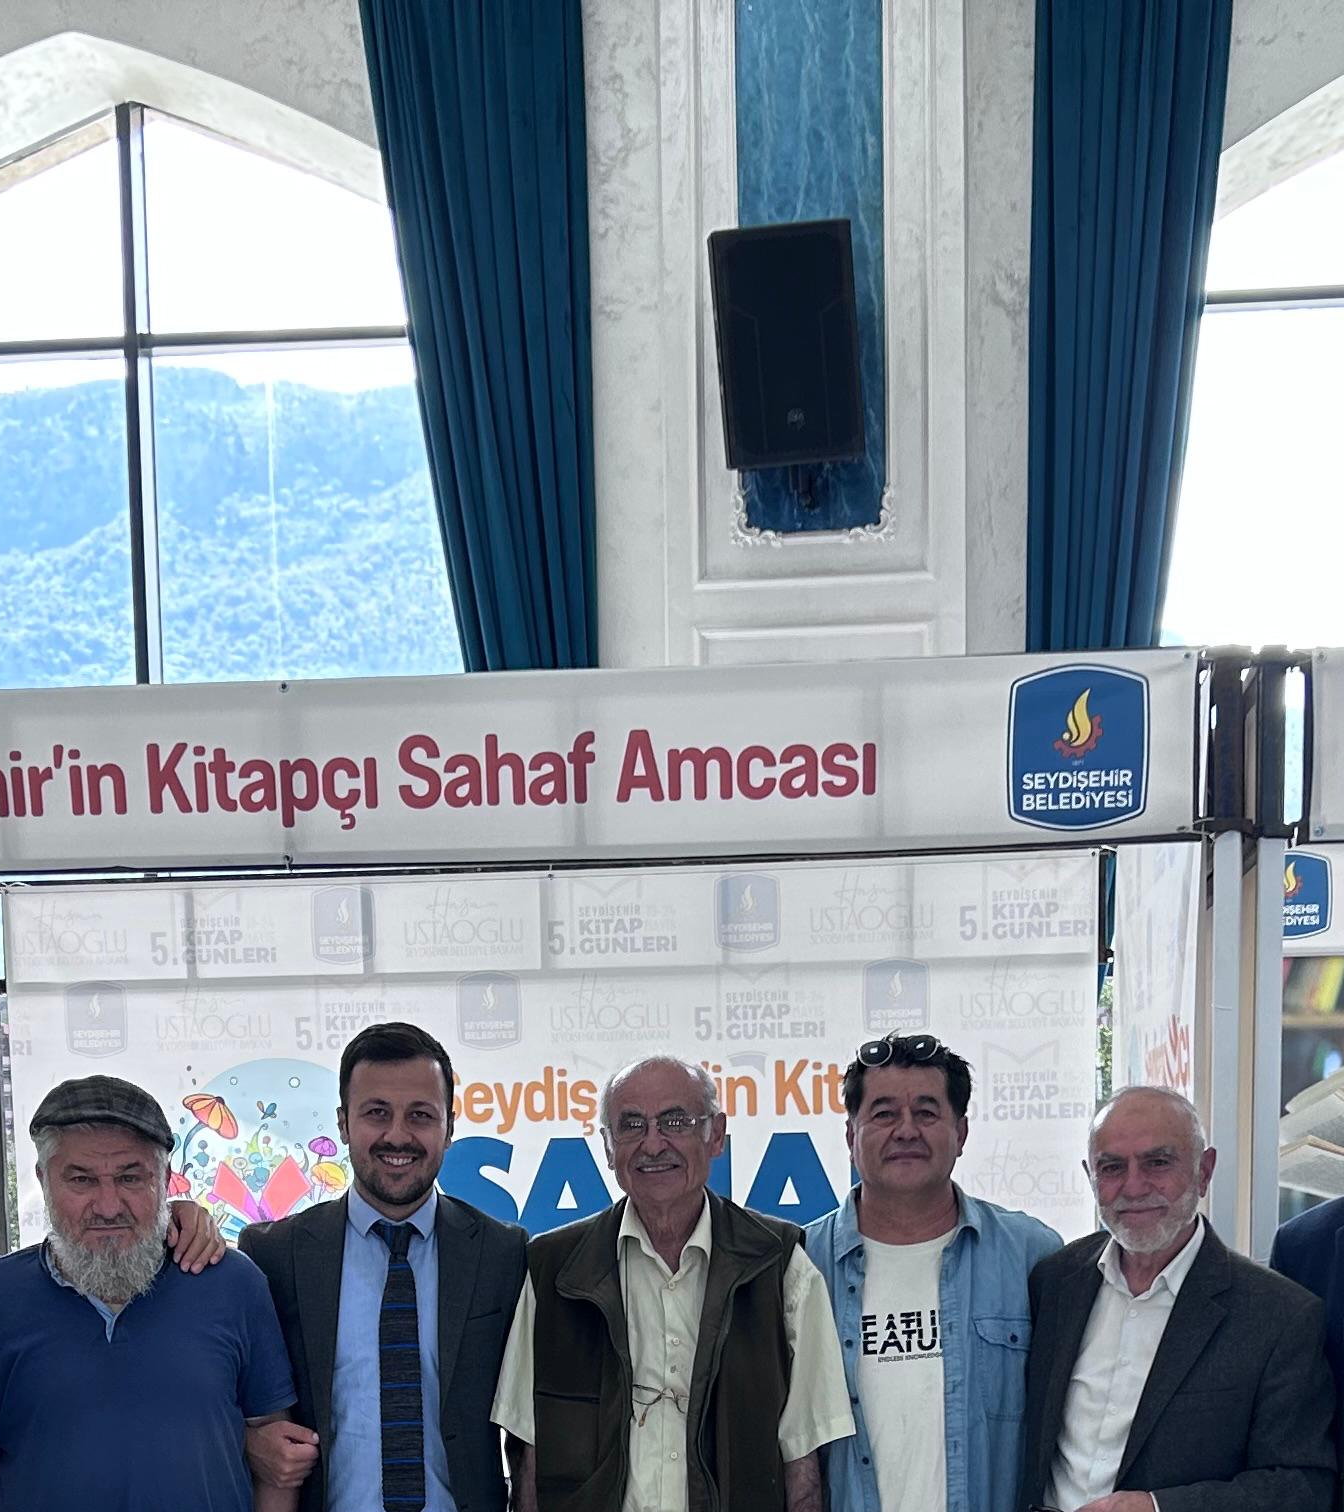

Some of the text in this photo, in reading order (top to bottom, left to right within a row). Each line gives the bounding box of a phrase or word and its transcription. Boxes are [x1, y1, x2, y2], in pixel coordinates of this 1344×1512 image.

[146, 742, 378, 831] Kitapçı
[399, 730, 597, 809] Sahaf
[616, 728, 877, 803] Amcası
[1022, 769, 1132, 790] SEYDİŞEHİR
[1022, 790, 1132, 811] BELEDİYESİ
[774, 1058, 848, 1116] Kit
